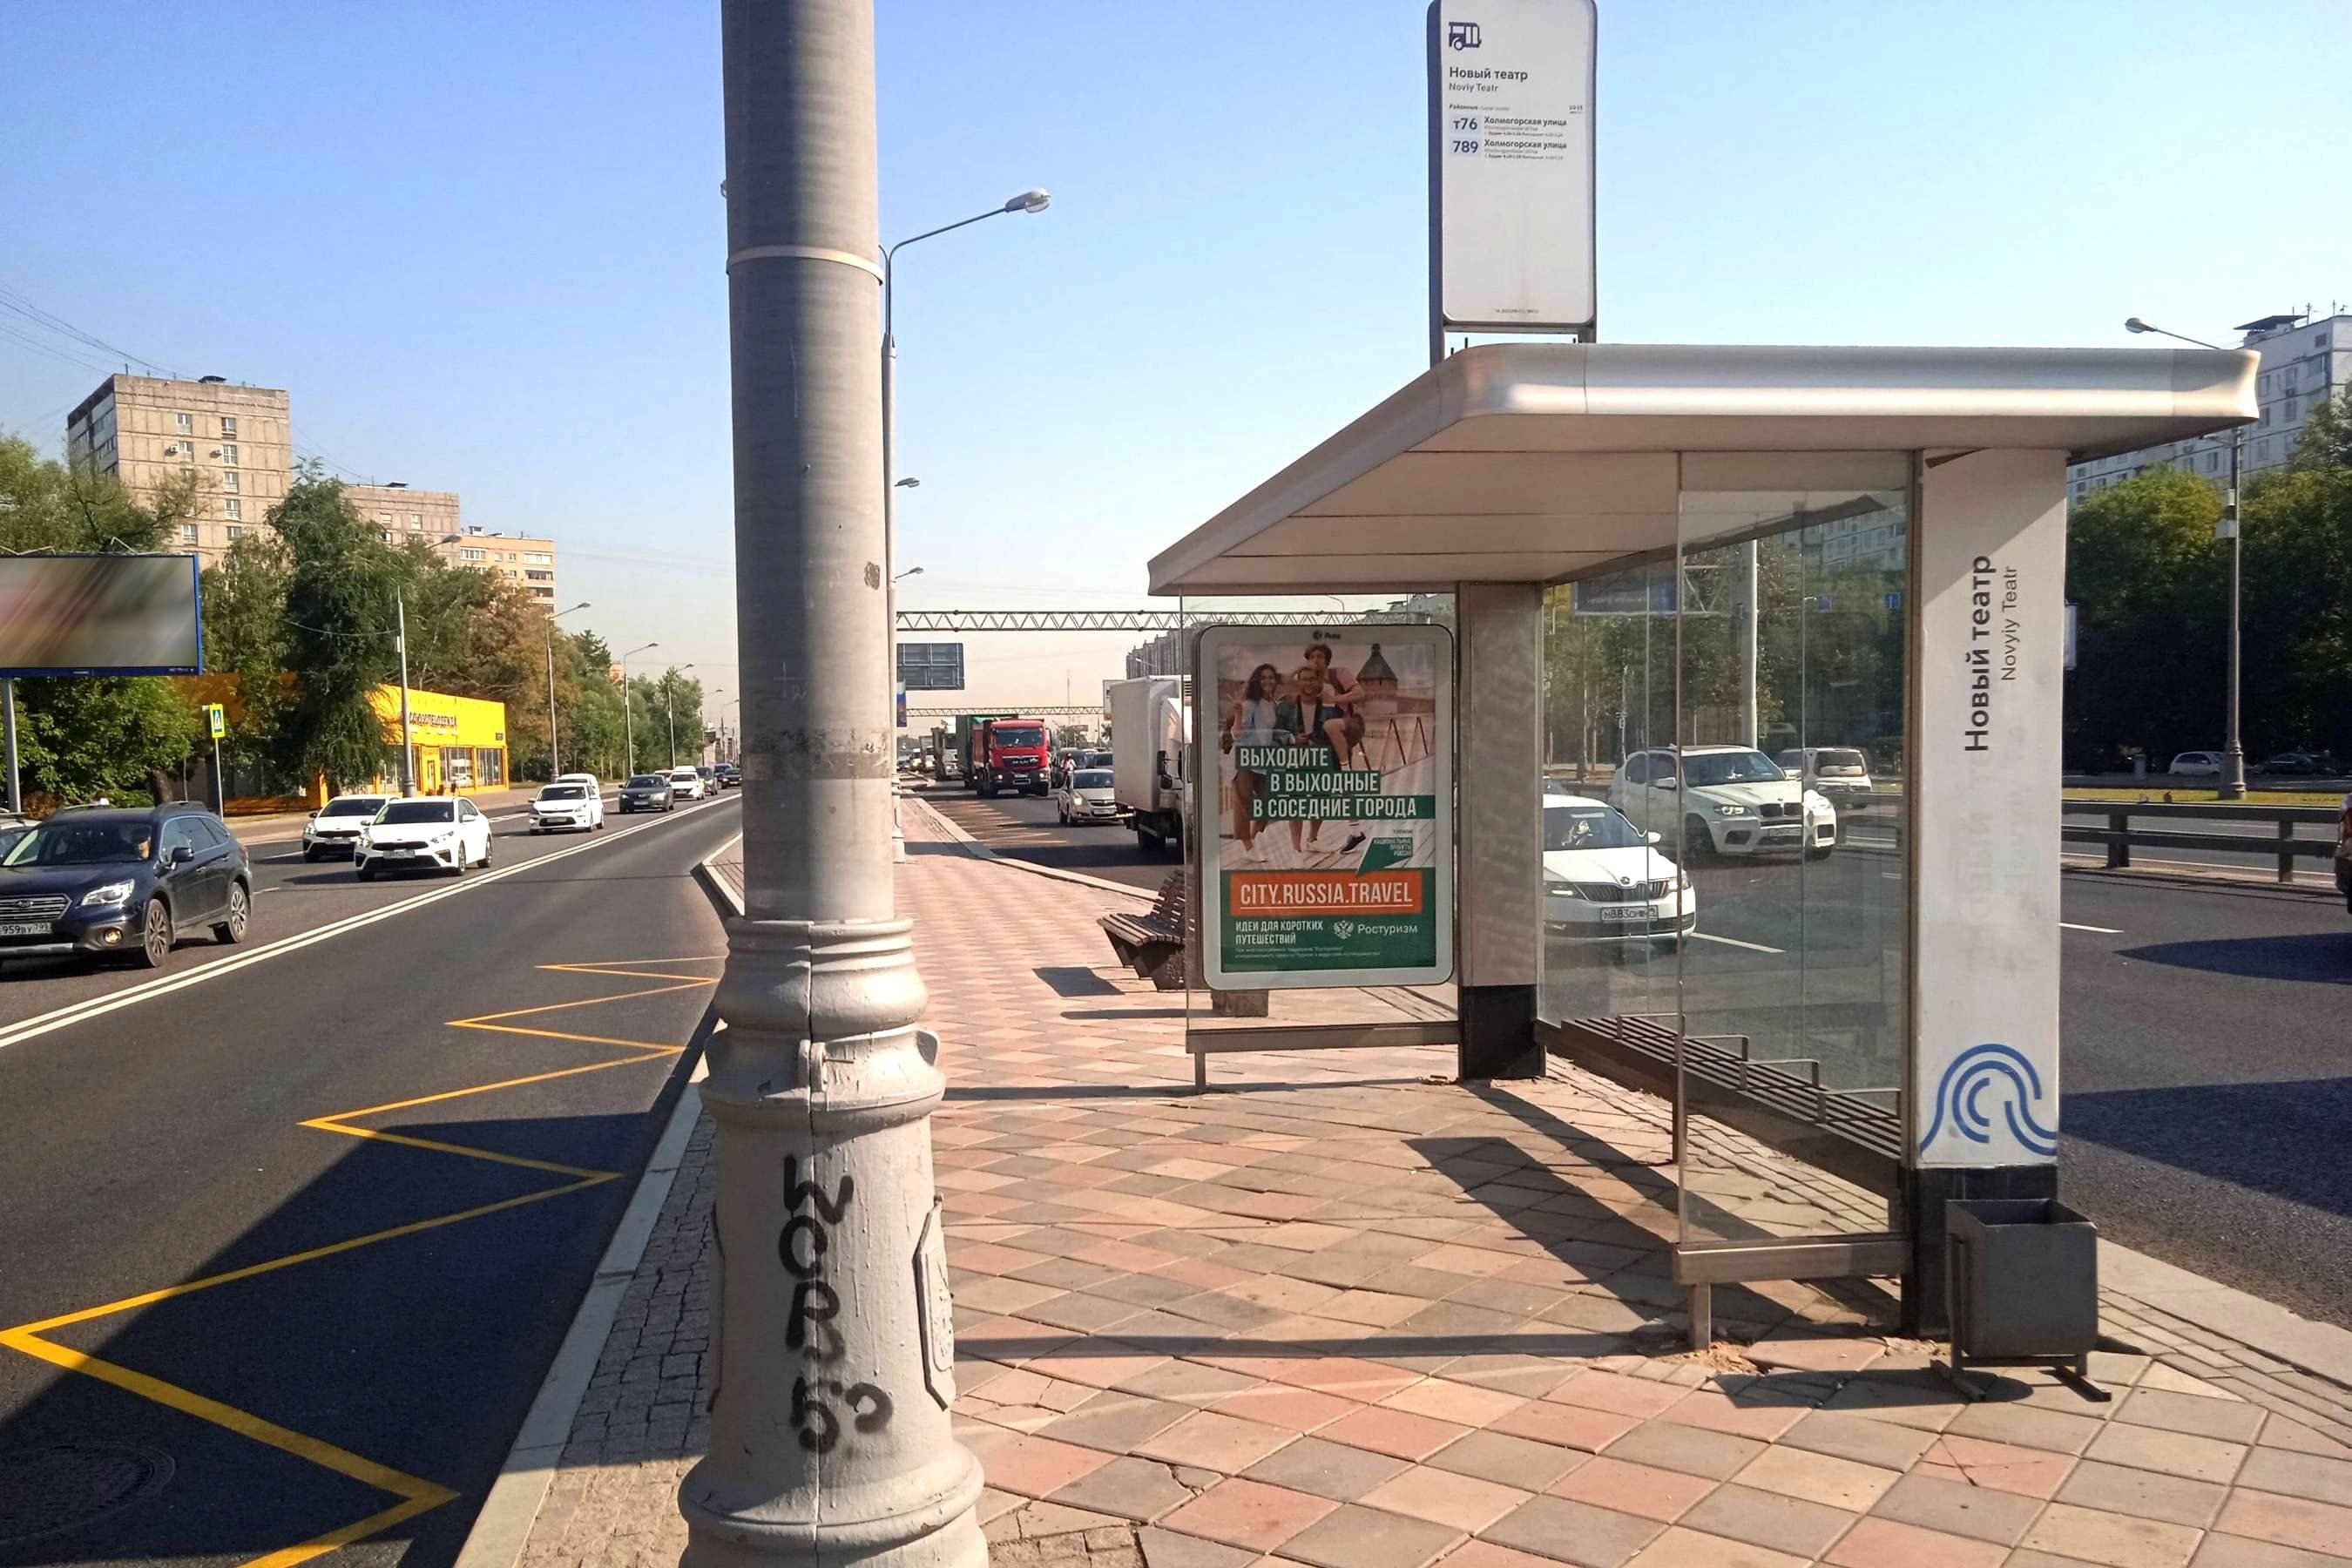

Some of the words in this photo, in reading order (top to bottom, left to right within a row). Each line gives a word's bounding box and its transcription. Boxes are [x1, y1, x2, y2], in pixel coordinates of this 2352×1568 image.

[1449, 66, 1491, 79] Новый
[1494, 69, 1528, 83] театр
[1477, 83, 1498, 92] Teatr
[1484, 116, 1542, 127] Холмогорская
[1543, 118, 1567, 127] улица
[1453, 140, 1479, 153] 789
[1484, 139, 1542, 150] Холмогорская
[1543, 141, 1567, 151] улица
[1972, 556, 1997, 641] театр
[2002, 566, 2017, 613] Teatr
[2001, 618, 2021, 680] Novyiy
[1964, 649, 1990, 751] Новый
[1240, 747, 1329, 768] ВЫХОДИТЕ
[1270, 774, 1281, 793] В
[1285, 772, 1379, 794] ВЫХОДНЫЕ
[1253, 800, 1263, 819] В
[1267, 798, 1351, 820] СОСЕДНИЕ
[1355, 797, 1417, 817] ГОРОДА
[1240, 882, 1413, 905] CITY.RUSSIA.TRAVEL
[1235, 921, 1259, 933] ИДЕИ
[1261, 921, 1279, 933] ДЛЯ
[1280, 920, 1323, 932] КОРОТКИХ
[1357, 923, 1418, 936] Ростуризм
[1235, 932, 1297, 946] ПУТЕШЕСТВИЙ
